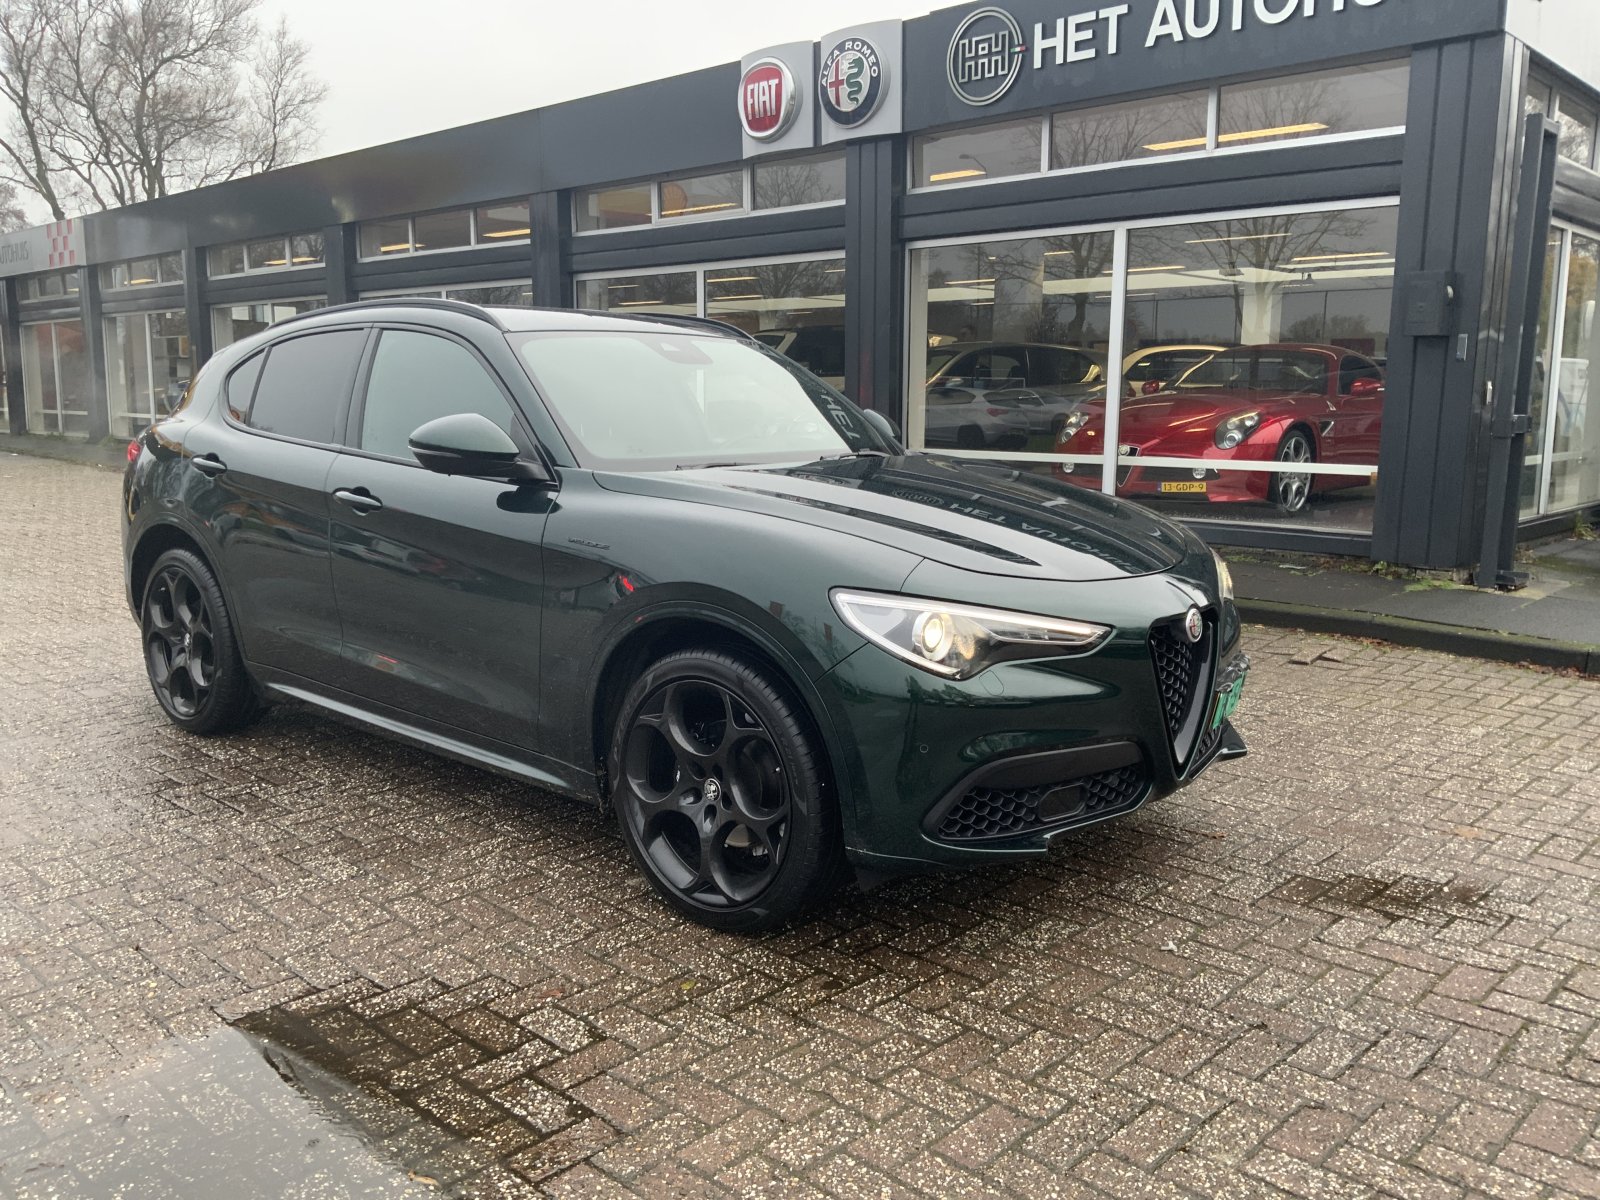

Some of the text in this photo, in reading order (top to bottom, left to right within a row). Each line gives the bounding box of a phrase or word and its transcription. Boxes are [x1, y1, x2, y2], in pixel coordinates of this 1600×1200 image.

[1033, 3, 1129, 69] HET
[821, 40, 879, 87] ALFA ROMEO
[746, 78, 780, 121] FIAT
[1162, 482, 1205, 491] 13-GDP-9
